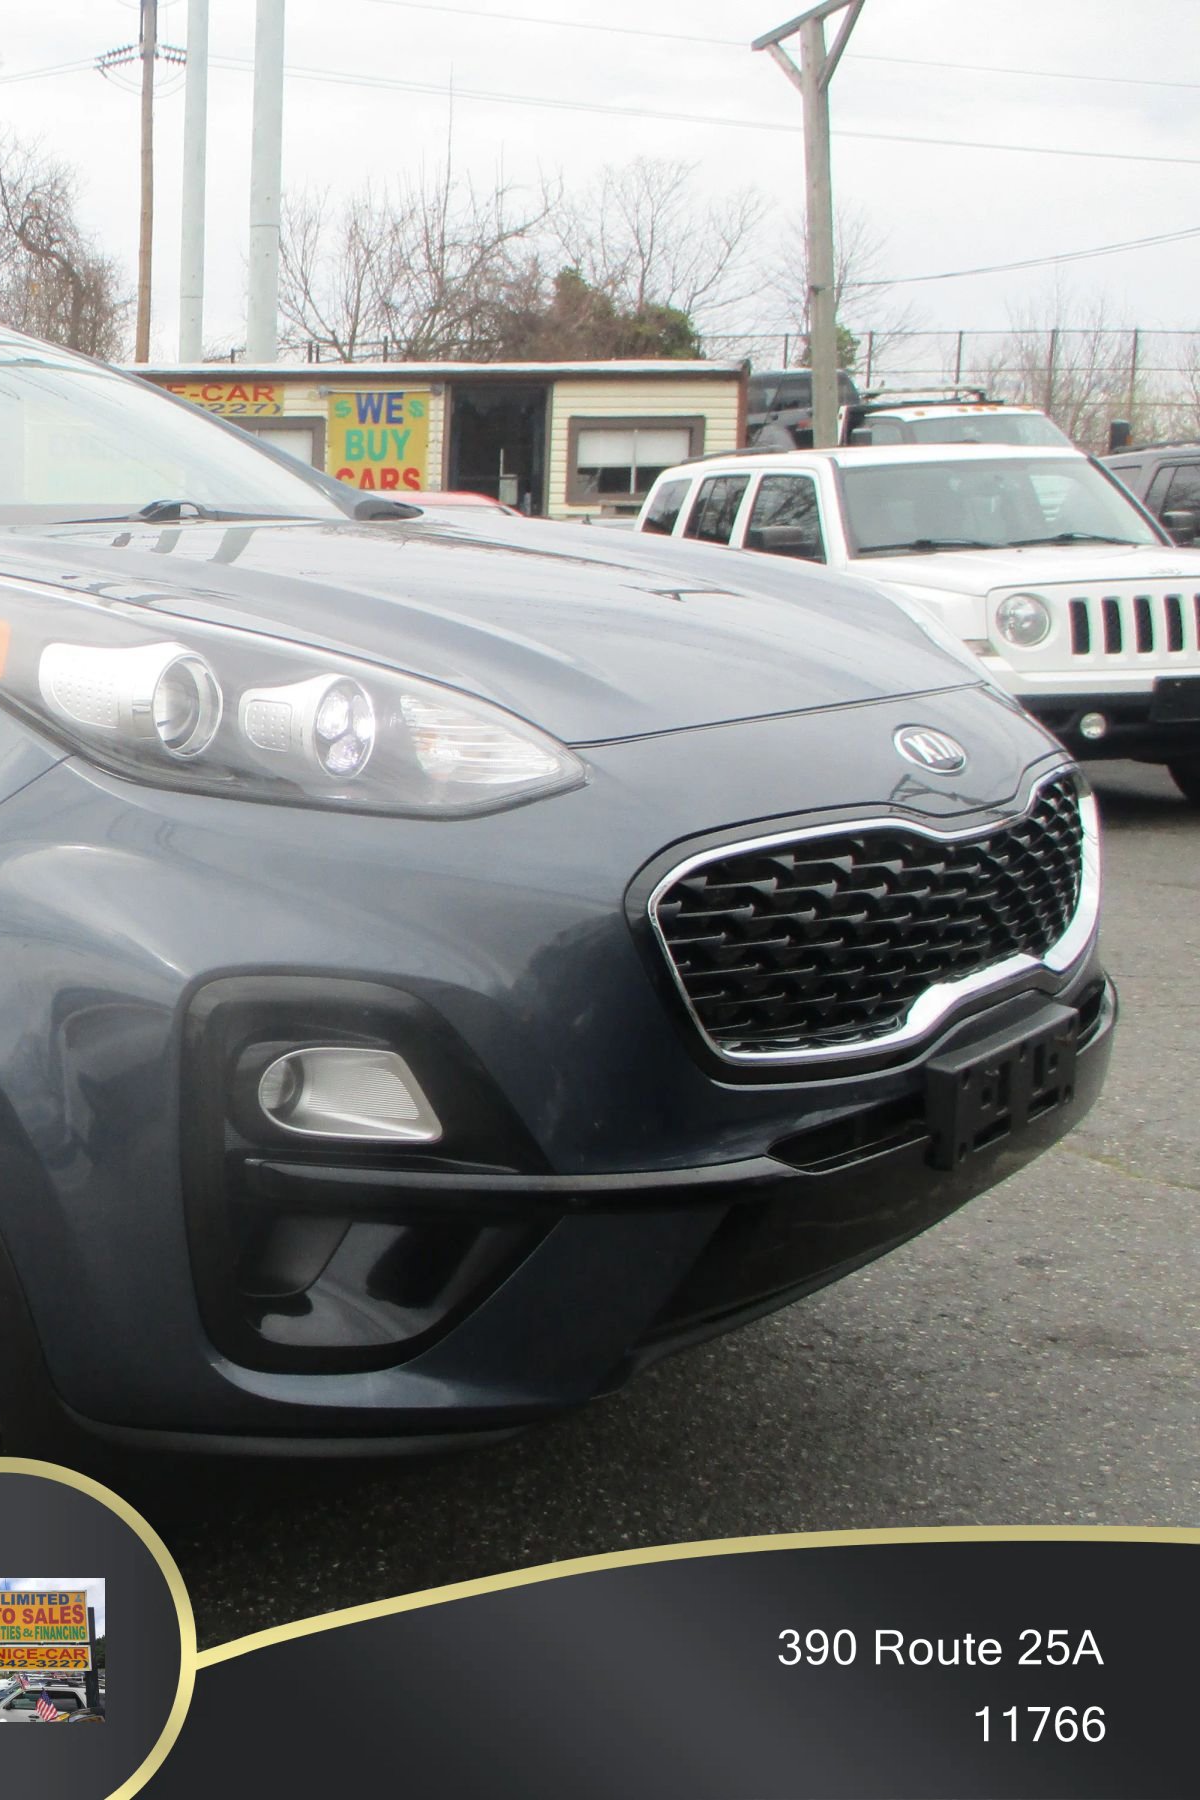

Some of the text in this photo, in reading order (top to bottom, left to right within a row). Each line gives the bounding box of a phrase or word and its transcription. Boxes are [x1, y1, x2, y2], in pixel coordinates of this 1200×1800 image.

[194, 402, 282, 415] 227)
[355, 391, 405, 425] WE
[345, 428, 412, 462] BUY
